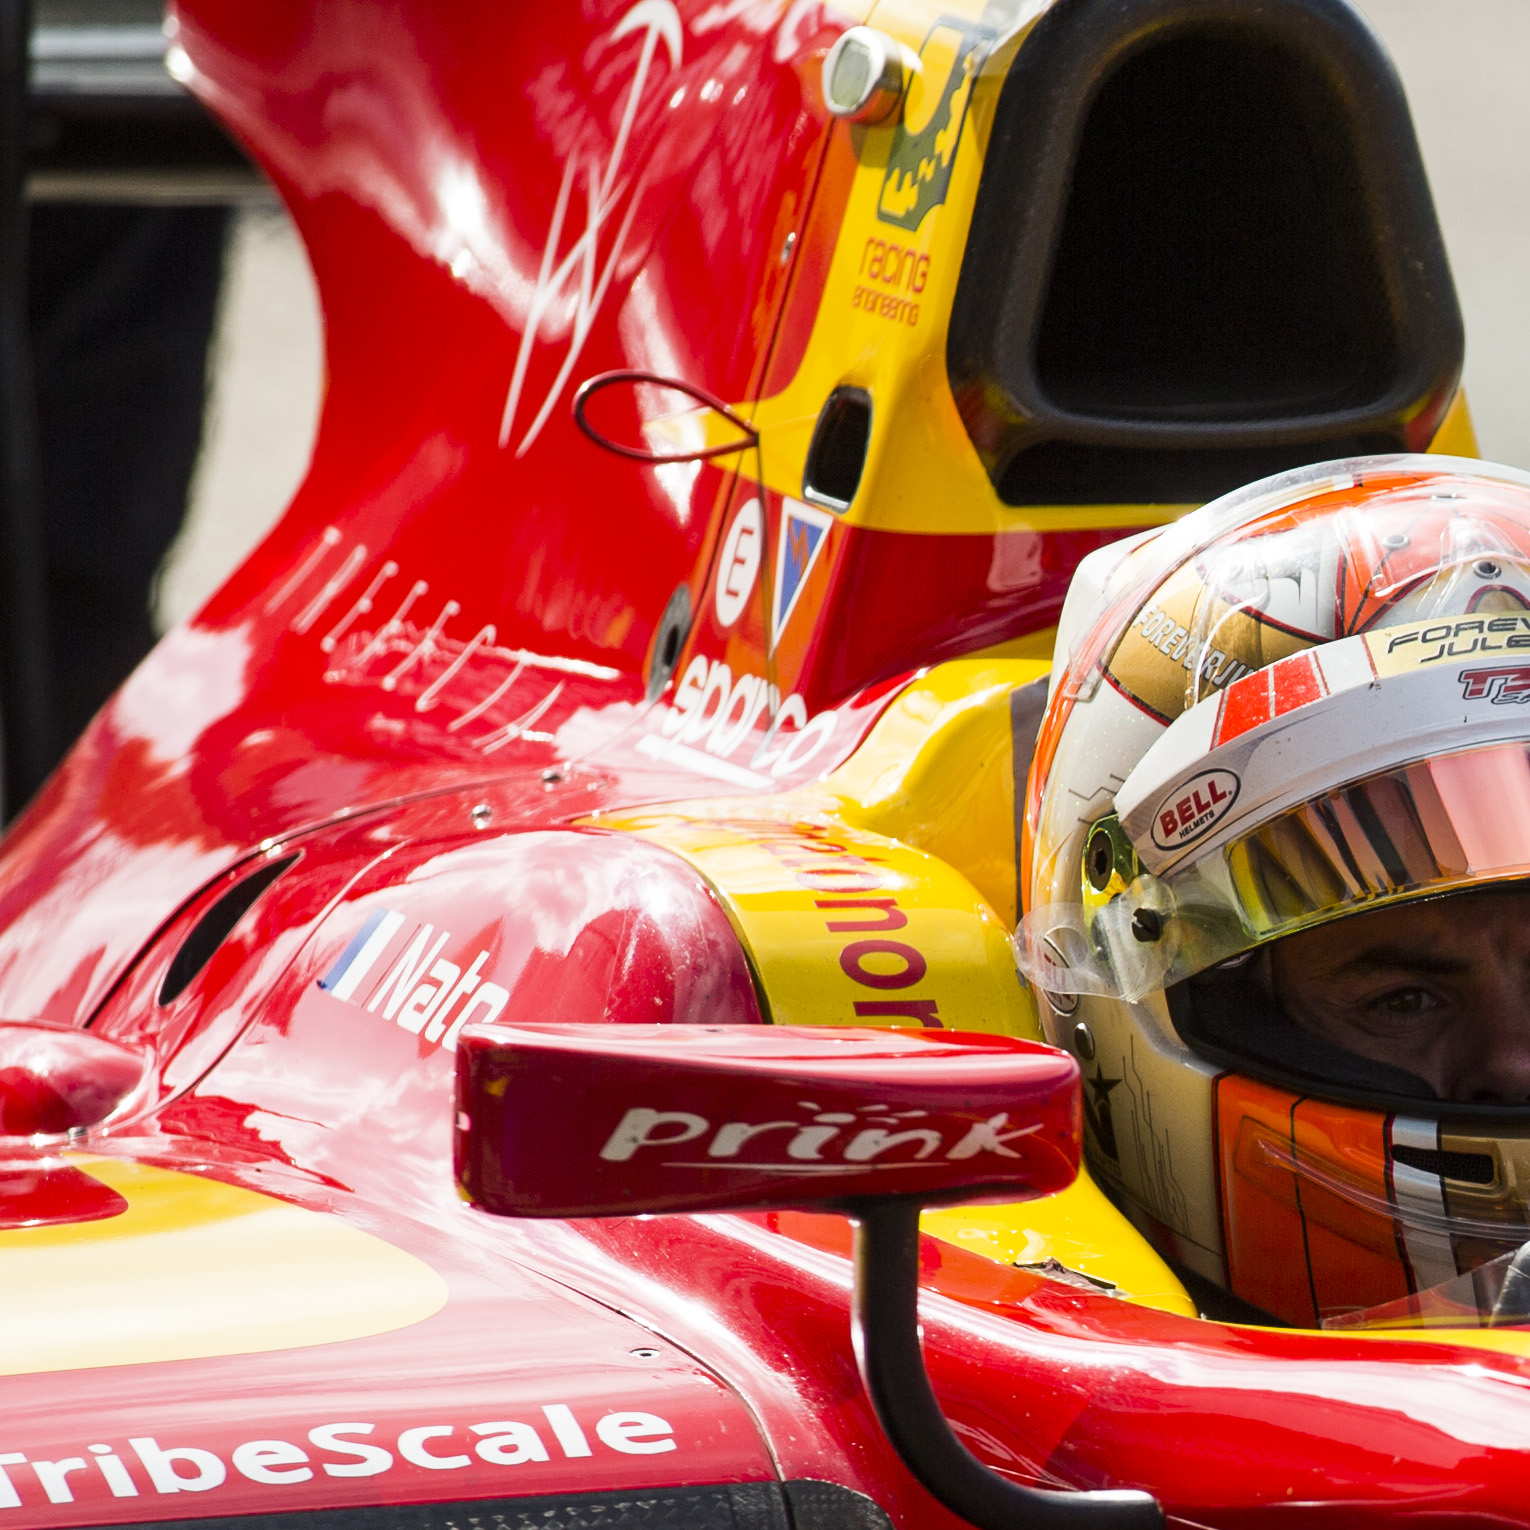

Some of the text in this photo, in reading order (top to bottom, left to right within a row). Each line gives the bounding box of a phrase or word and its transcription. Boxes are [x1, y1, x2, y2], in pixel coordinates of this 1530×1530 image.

[662, 654, 838, 777] sparco
[1159, 780, 1228, 839] BELL
[1178, 810, 1215, 839] HELMETS
[366, 922, 511, 1053] Nato
